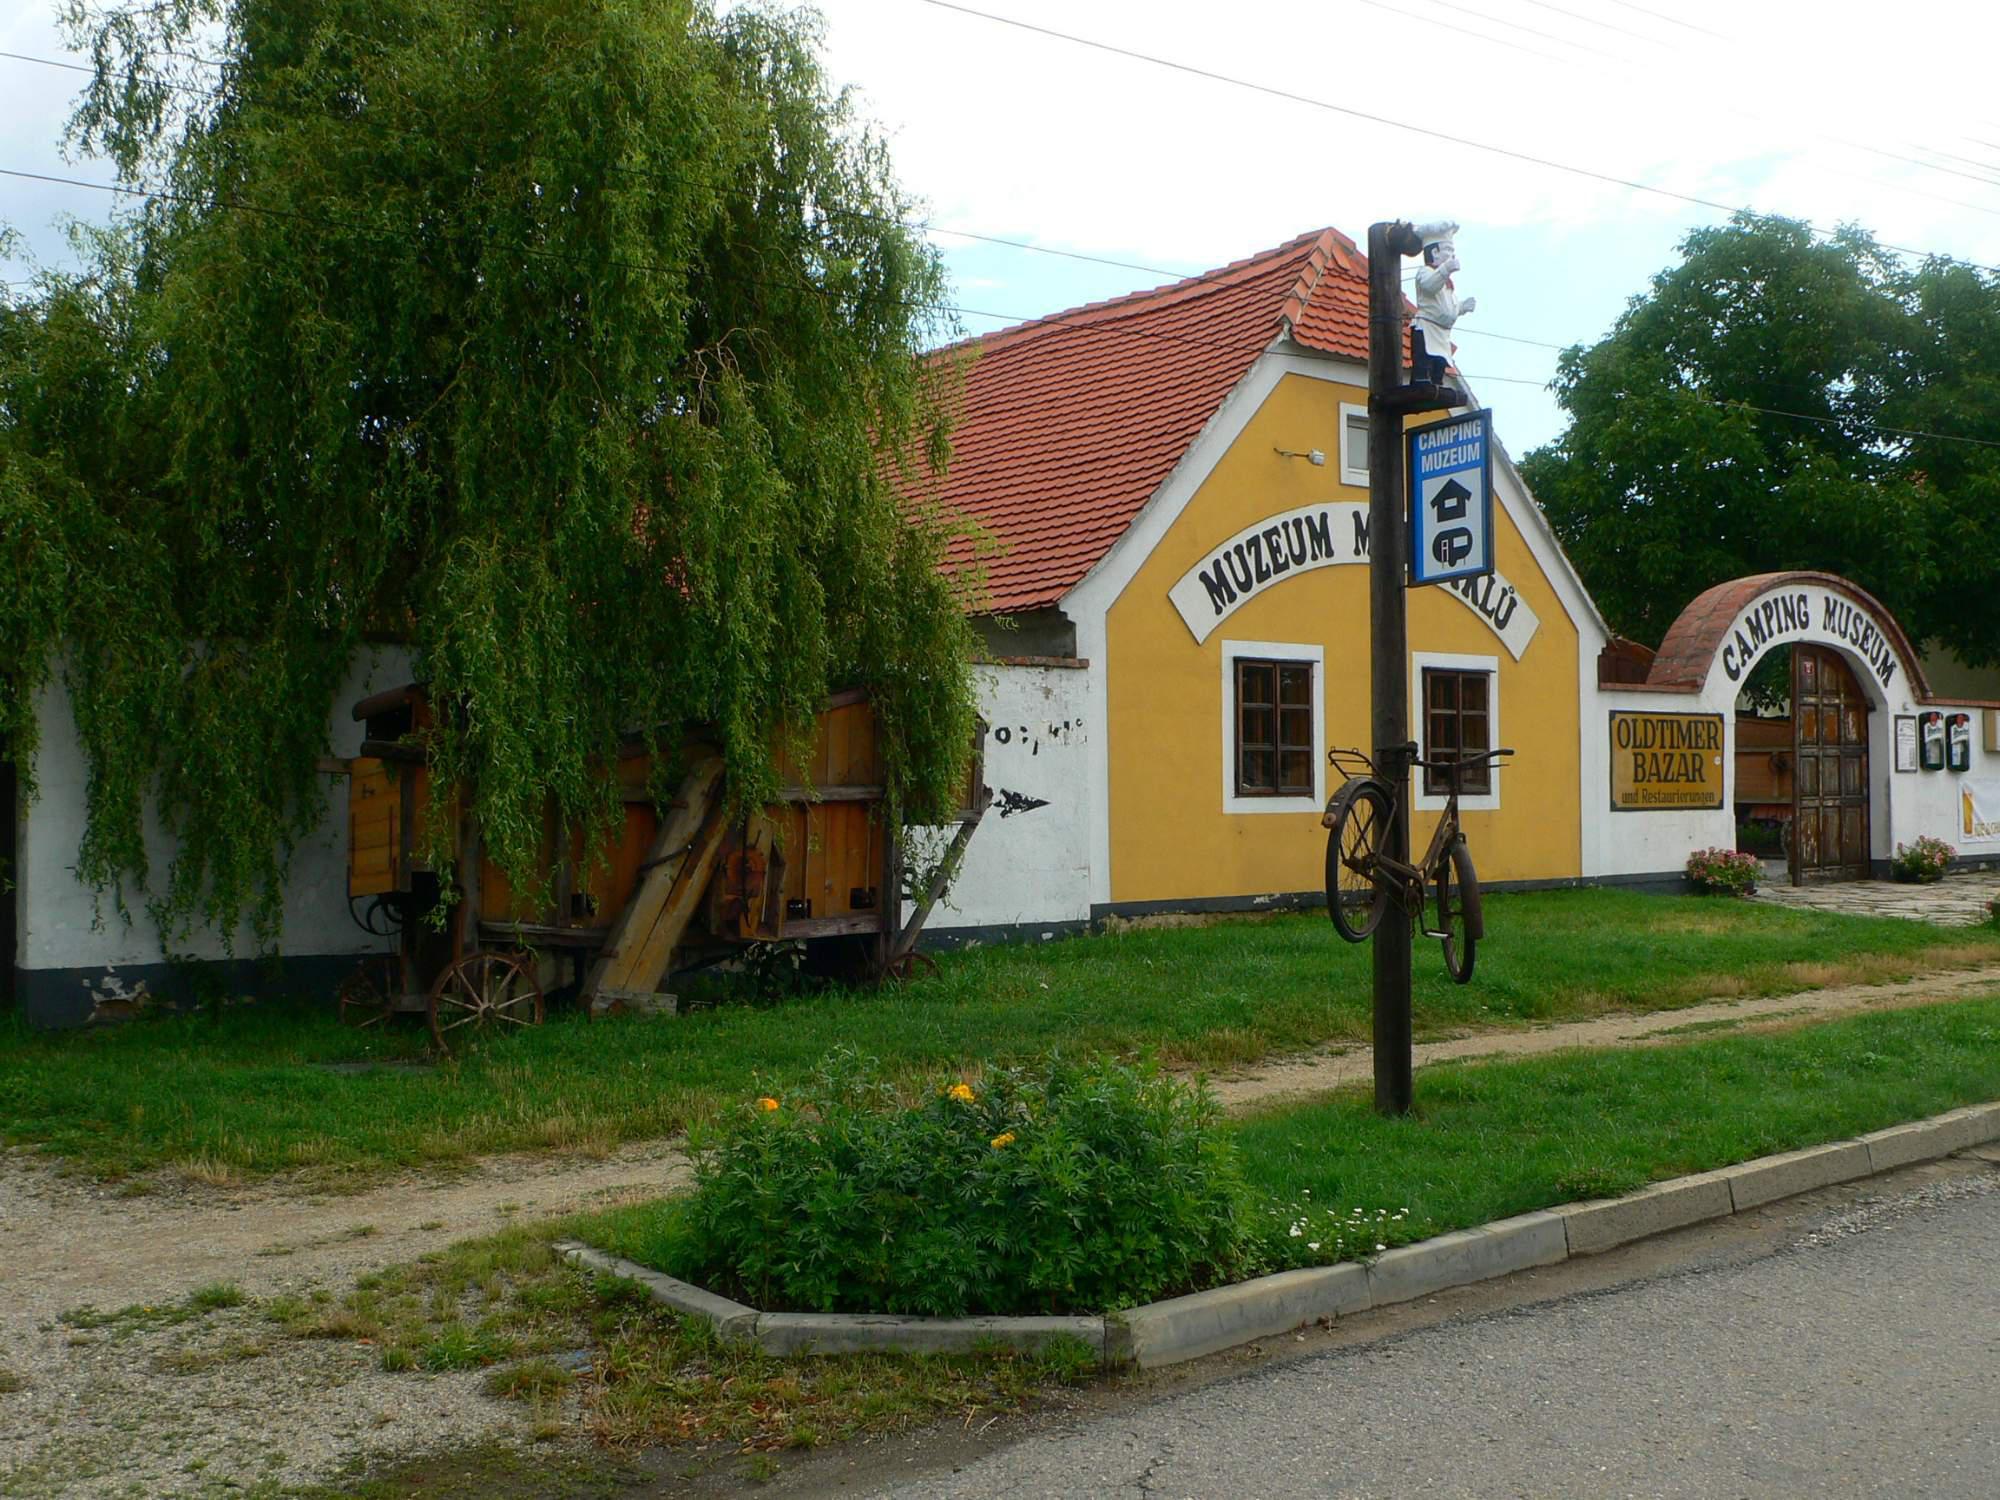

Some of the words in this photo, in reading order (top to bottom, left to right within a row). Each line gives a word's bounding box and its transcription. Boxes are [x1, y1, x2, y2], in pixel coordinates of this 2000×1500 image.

[1418, 418, 1482, 452] CAMPING
[1421, 441, 1481, 473] MUZEUM
[1198, 511, 1335, 616] MUZEUM
[1722, 593, 1810, 682] CAMPING
[1822, 595, 1898, 689] MUSEUM
[1616, 718, 1721, 750] OLDTIMER
[1632, 751, 1707, 784] BAZAR
[1621, 787, 1640, 805] und
